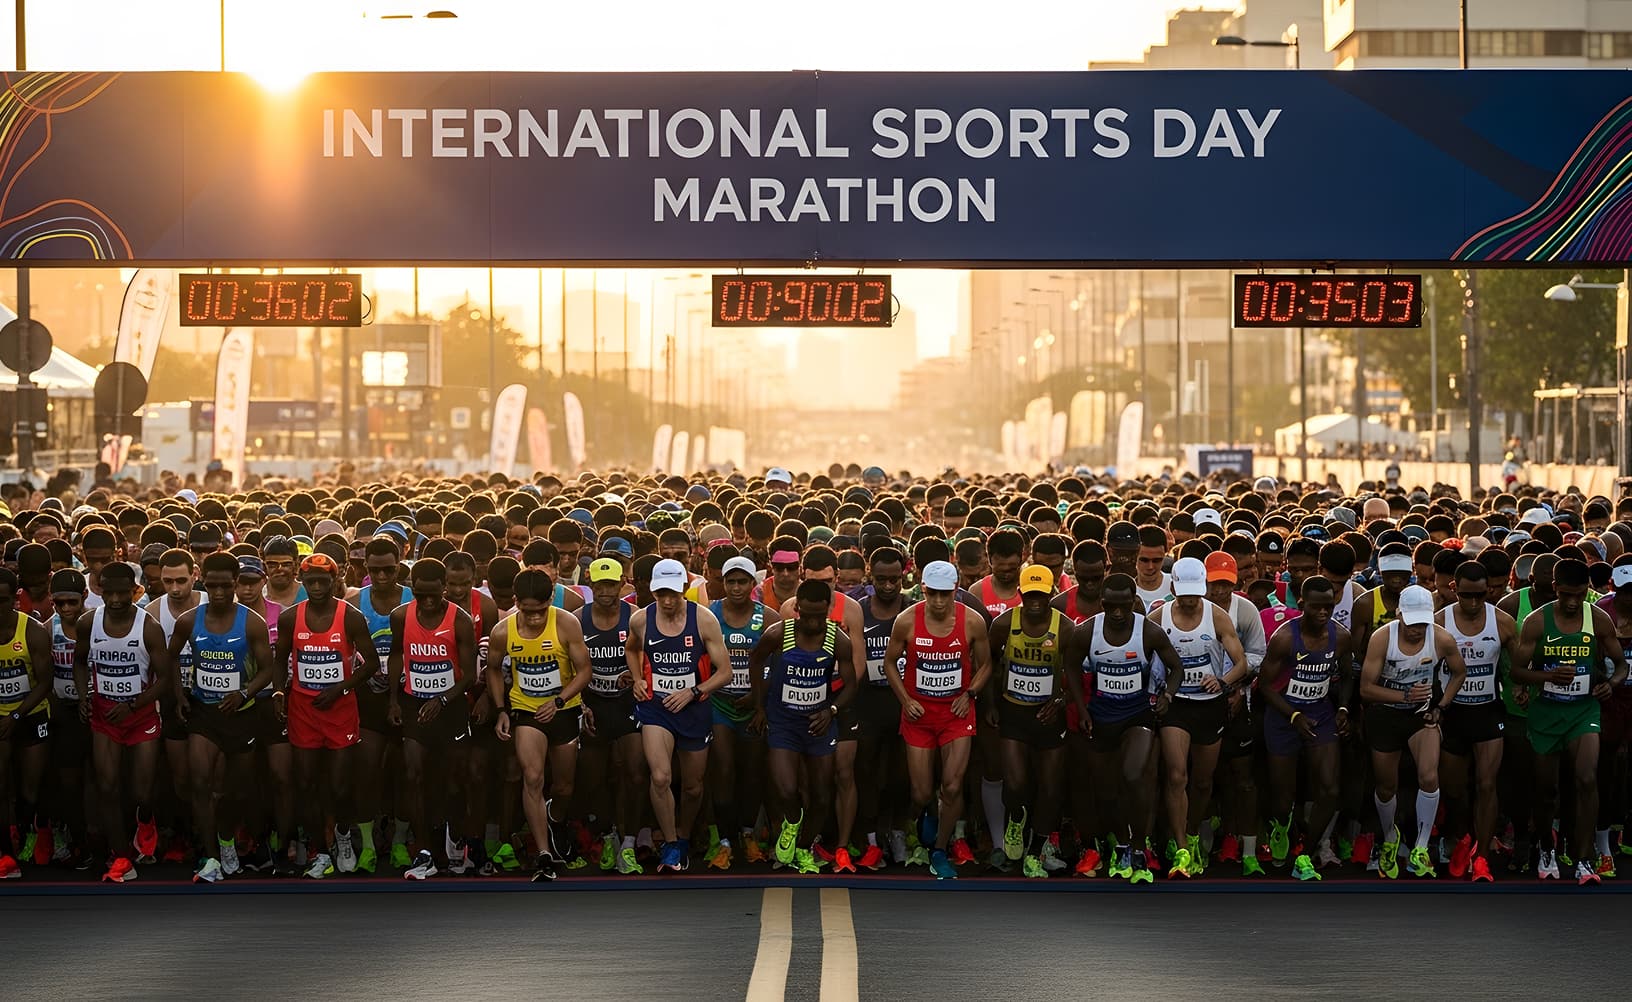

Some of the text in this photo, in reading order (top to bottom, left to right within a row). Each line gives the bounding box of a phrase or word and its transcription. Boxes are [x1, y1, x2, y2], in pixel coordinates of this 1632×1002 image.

[323, 108, 1282, 158] INTERNATIONAL SPORTS DAY
[654, 177, 996, 223] MARATHON
[187, 280, 353, 321] 00:3602
[720, 281, 885, 322] 00:9002
[1242, 281, 1414, 323] 00:3503
